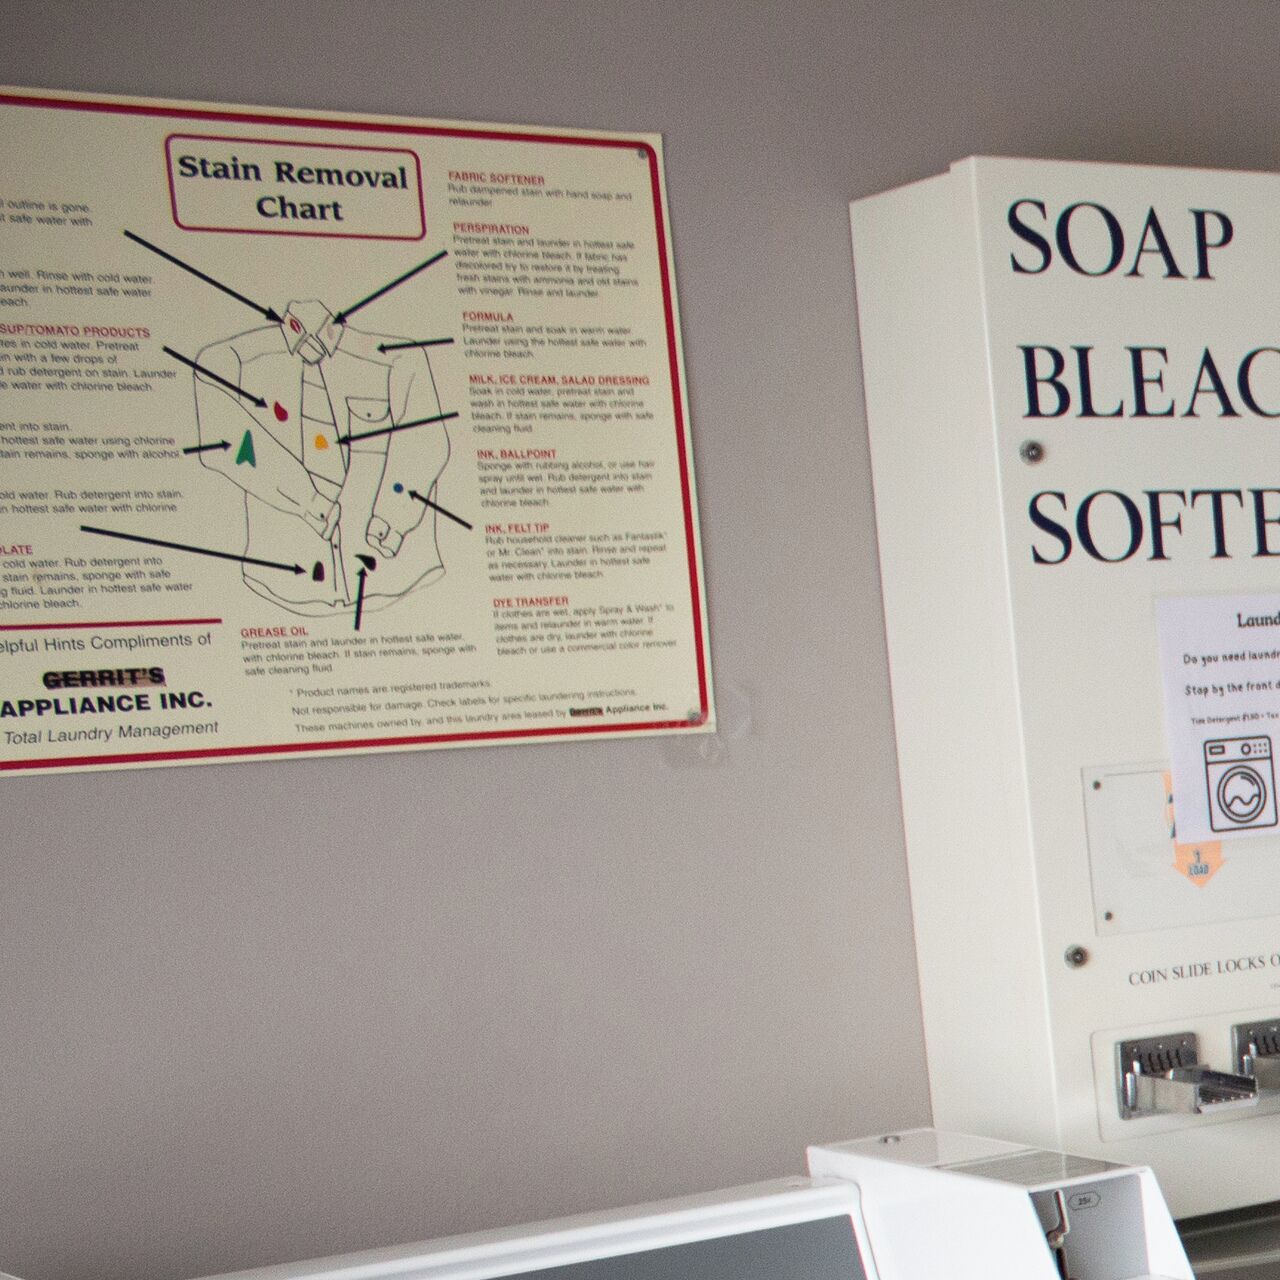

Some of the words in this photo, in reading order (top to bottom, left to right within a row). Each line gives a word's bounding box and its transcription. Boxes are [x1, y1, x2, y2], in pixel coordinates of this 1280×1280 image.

[178, 155, 262, 181] Stain
[275, 161, 408, 189] Removal
[448, 171, 487, 183] FABRIC
[489, 173, 545, 185] SOFTENER
[256, 196, 344, 221] Chart
[35, 215, 68, 226] water
[70, 216, 93, 227] with
[452, 222, 530, 235] PERSPIRATION
[1006, 197, 1235, 281] SOAP
[36, 270, 69, 281] Rinse
[71, 271, 95, 281] with
[97, 272, 120, 282] cold
[55, 285, 94, 295] hottest
[96, 286, 119, 296] safe
[462, 311, 514, 322] FORMULA
[83, 326, 151, 338] PRODUCTS
[34, 340, 58, 350] cold
[95, 341, 140, 351] Pretreat
[13, 353, 37, 363] with
[72, 354, 104, 366] drops
[29, 367, 82, 379] detergent
[134, 369, 177, 379] Launder
[45, 381, 68, 391] with
[70, 381, 114, 391] chlorine
[500, 375, 516, 385] ICE
[561, 375, 596, 385] SALAD
[598, 375, 650, 385] DRESSING
[18, 422, 40, 432] into
[42, 436, 65, 445] safe
[68, 436, 98, 445] water
[101, 436, 131, 447] using
[133, 436, 176, 445] chlorine
[74, 451, 115, 461] sponge
[118, 449, 139, 459] with
[476, 449, 499, 461] INK,
[500, 449, 557, 459] BALLPOINT
[53, 489, 77, 499] Rub
[80, 489, 132, 501] detergent
[134, 489, 153, 499] into
[11, 504, 49, 513] hottest
[52, 503, 76, 513] safe
[78, 503, 108, 513] water
[110, 503, 132, 513] with
[135, 503, 178, 513] chlorine
[508, 523, 532, 534] FELT
[534, 523, 550, 533] TIP
[2, 559, 27, 569] cold
[63, 557, 87, 568] Rub
[90, 556, 141, 569] detergent
[143, 555, 163, 566] into
[2, 572, 29, 582] stain
[82, 572, 122, 583] sponge
[124, 569, 146, 580] with
[149, 569, 172, 579] safe
[40, 584, 85, 595] Launder
[88, 584, 98, 594] in
[100, 583, 137, 593] hottest
[139, 582, 162, 592] safe
[165, 581, 193, 592] water
[492, 597, 513, 608] DYE
[515, 595, 569, 607] TRANSFER
[240, 627, 288, 638] GREASE
[290, 626, 310, 637] OIL
[43, 637, 86, 653] Hints
[90, 632, 193, 654] Compliments
[197, 631, 212, 646] of
[1182, 653, 1198, 666] Do
[1201, 654, 1219, 667] you
[1221, 650, 1247, 663] need
[1184, 683, 1209, 699] Stop
[1211, 682, 1226, 697] by
[1227, 680, 1244, 693] the
[1246, 678, 1273, 692] front
[0, 694, 151, 718] APPLIANCE
[160, 691, 213, 710] INC.
[4, 730, 42, 745] Total
[47, 726, 113, 743] Laundry
[118, 721, 219, 740] Management
[1187, 862, 1210, 877] LOAD
[1128, 966, 1168, 988] COIN
[1172, 960, 1214, 982] SLIDE
[1216, 953, 1267, 976] LOCKS
